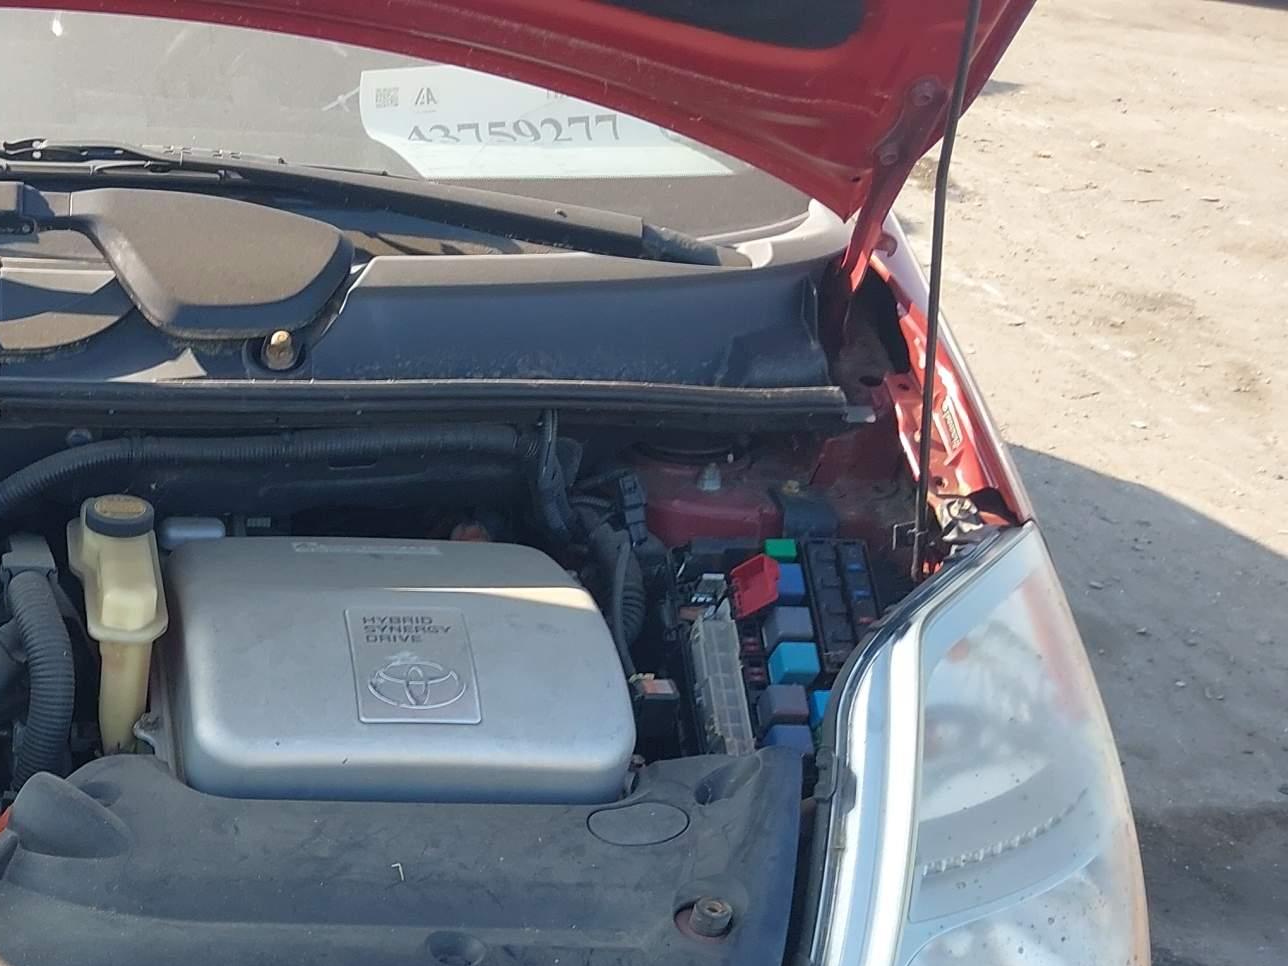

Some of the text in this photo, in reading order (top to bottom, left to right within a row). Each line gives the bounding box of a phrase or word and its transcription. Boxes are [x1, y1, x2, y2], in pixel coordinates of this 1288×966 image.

[362, 616, 433, 625] HYBRID
[363, 625, 452, 634] SYNERGY
[366, 634, 423, 643] DRIVE
